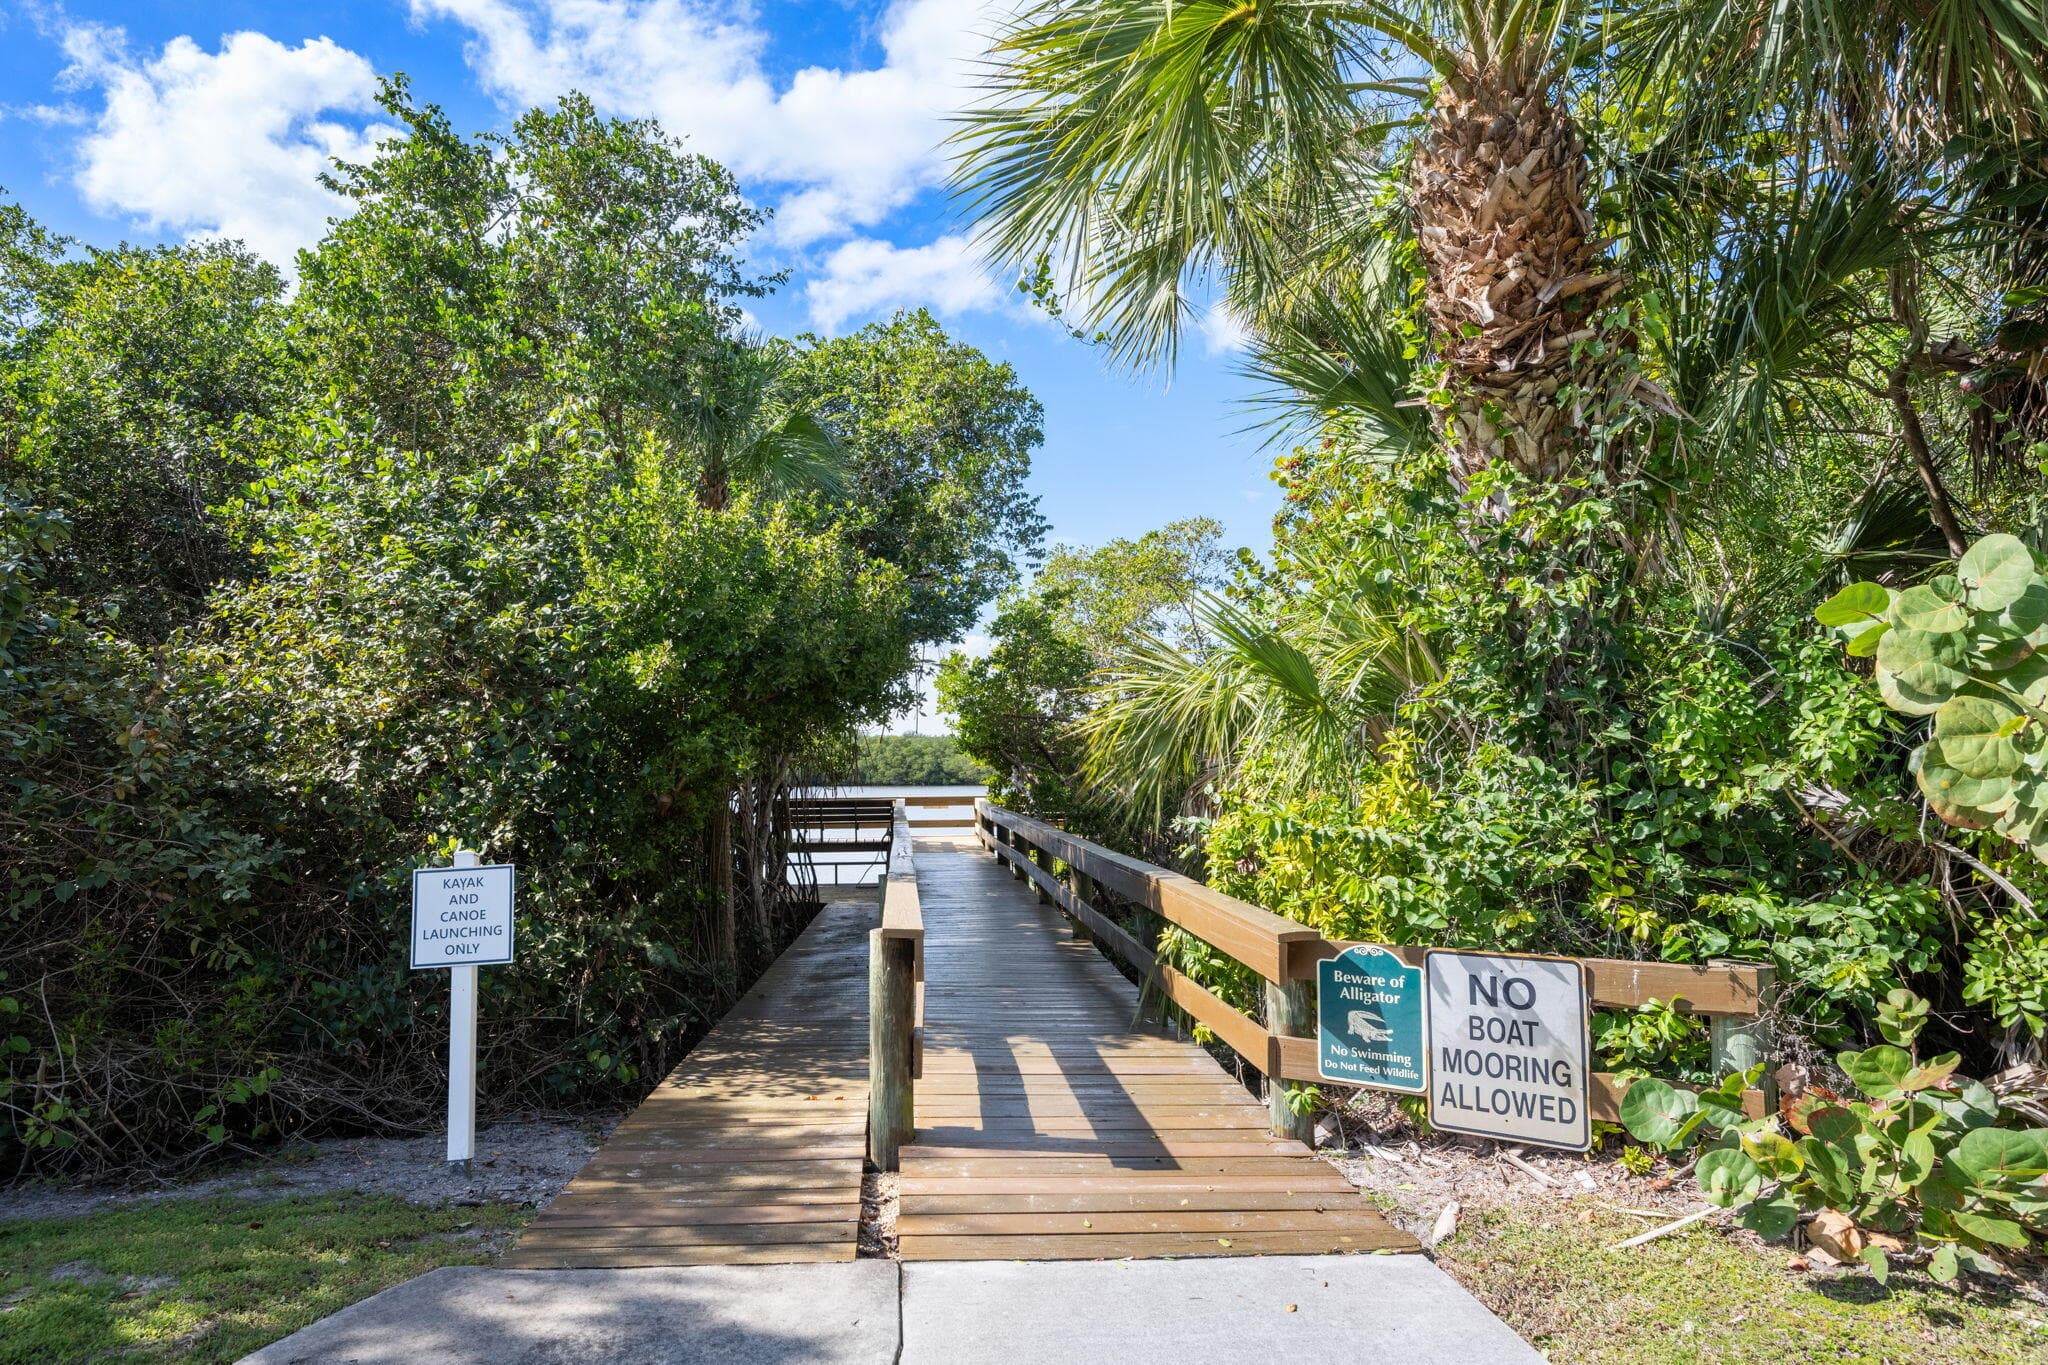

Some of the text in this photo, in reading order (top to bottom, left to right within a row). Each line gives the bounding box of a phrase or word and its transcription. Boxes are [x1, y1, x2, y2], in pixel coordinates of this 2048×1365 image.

[443, 877, 484, 890] KAYAK
[449, 893, 479, 905] AND
[440, 909, 486, 922] CANOE
[423, 925, 502, 940] LAUNCHING
[444, 943, 480, 955] ONLY
[1334, 970, 1406, 988] Beware of
[1340, 987, 1401, 1005] Alligator
[1468, 974, 1537, 1011] NO
[1469, 1015, 1539, 1047] BOAT
[1331, 1045, 1412, 1067] No Swimming
[1325, 1059, 1419, 1080] Do Not Feed Wildlife
[1442, 1047, 1572, 1088] MOORING
[1440, 1082, 1577, 1125] ALLOWED
